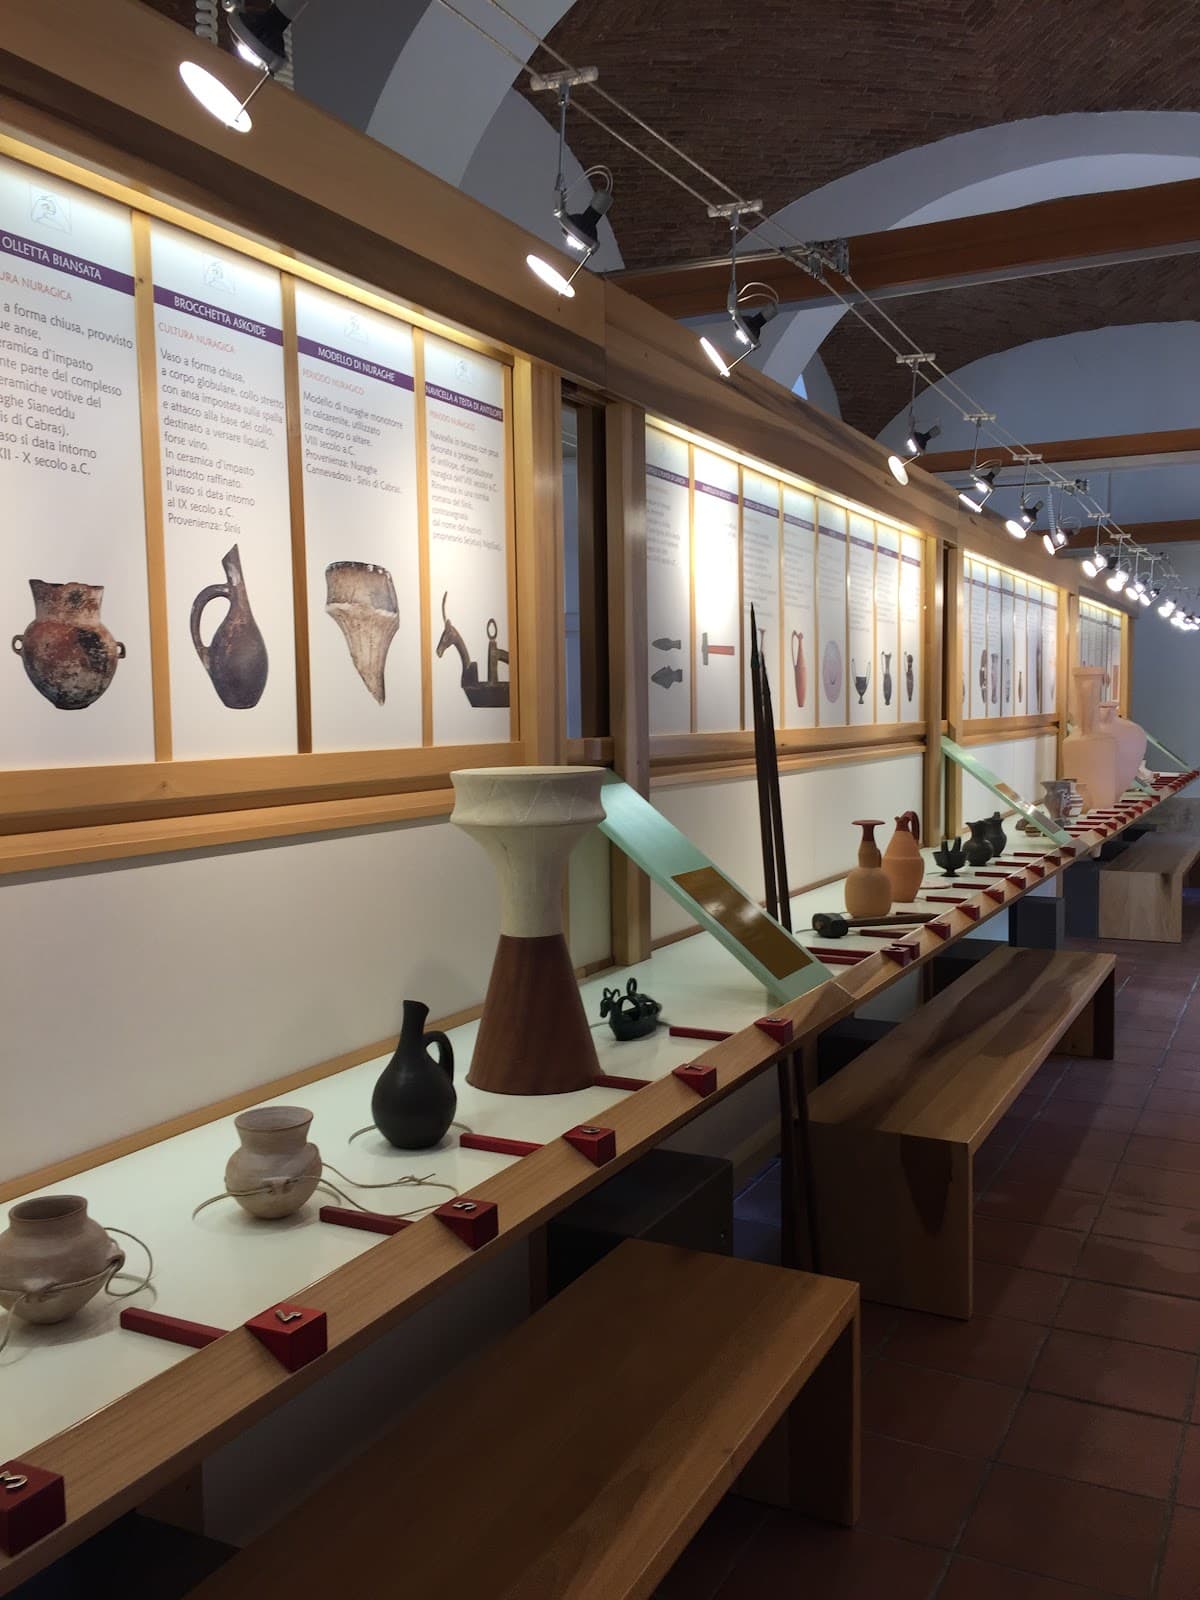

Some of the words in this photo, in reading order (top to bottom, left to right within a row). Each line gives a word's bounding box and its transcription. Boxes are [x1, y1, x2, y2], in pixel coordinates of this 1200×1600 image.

[2, 236, 50, 262] OLLETTA
[52, 253, 102, 280] BIANSATA
[22, 278, 72, 301] NURAGICA
[4, 303, 10, 312] a
[14, 302, 47, 323] forma
[50, 315, 84, 336] chiusa,
[88, 328, 133, 349] provvisto
[174, 296, 232, 324] BROCCHETTA
[233, 318, 267, 337] ASKOIDE
[14, 324, 41, 340] anse,
[159, 322, 195, 340] CULTURA
[160, 348, 181, 364] Vaso
[184, 358, 189, 367] a
[192, 358, 217, 375] forma
[318, 347, 353, 367] MODELLO
[354, 359, 362, 369] DI
[362, 363, 396, 382] NURAGHE
[21, 363, 48, 377] parte
[52, 369, 68, 382] del
[72, 376, 122, 396] complesso
[161, 367, 167, 376] a
[169, 370, 195, 384] corpo
[51, 388, 83, 404] votive
[86, 396, 101, 408] del
[162, 384, 178, 395] con
[181, 389, 200, 401] ansa
[303, 391, 334, 408] Modello
[27, 398, 75, 419] Sianeddu
[163, 401, 169, 409] e
[171, 402, 202, 418] attacco
[204, 410, 219, 422] alla
[11, 413, 22, 425] di
[26, 416, 69, 437] Cabras).
[163, 416, 203, 434] destinato
[304, 422, 324, 434] come
[21, 433, 28, 445] si
[32, 436, 55, 451] data
[59, 440, 97, 459] intorno
[164, 431, 186, 446] forse
[22, 451, 31, 464] X
[35, 456, 67, 471] secolo
[165, 448, 174, 459] In
[177, 452, 213, 468] ceramica
[166, 465, 205, 481] piuttosto
[175, 484, 195, 495] vaso
[197, 487, 203, 496] si
[206, 488, 223, 500] data
[190, 502, 216, 515] secolo
